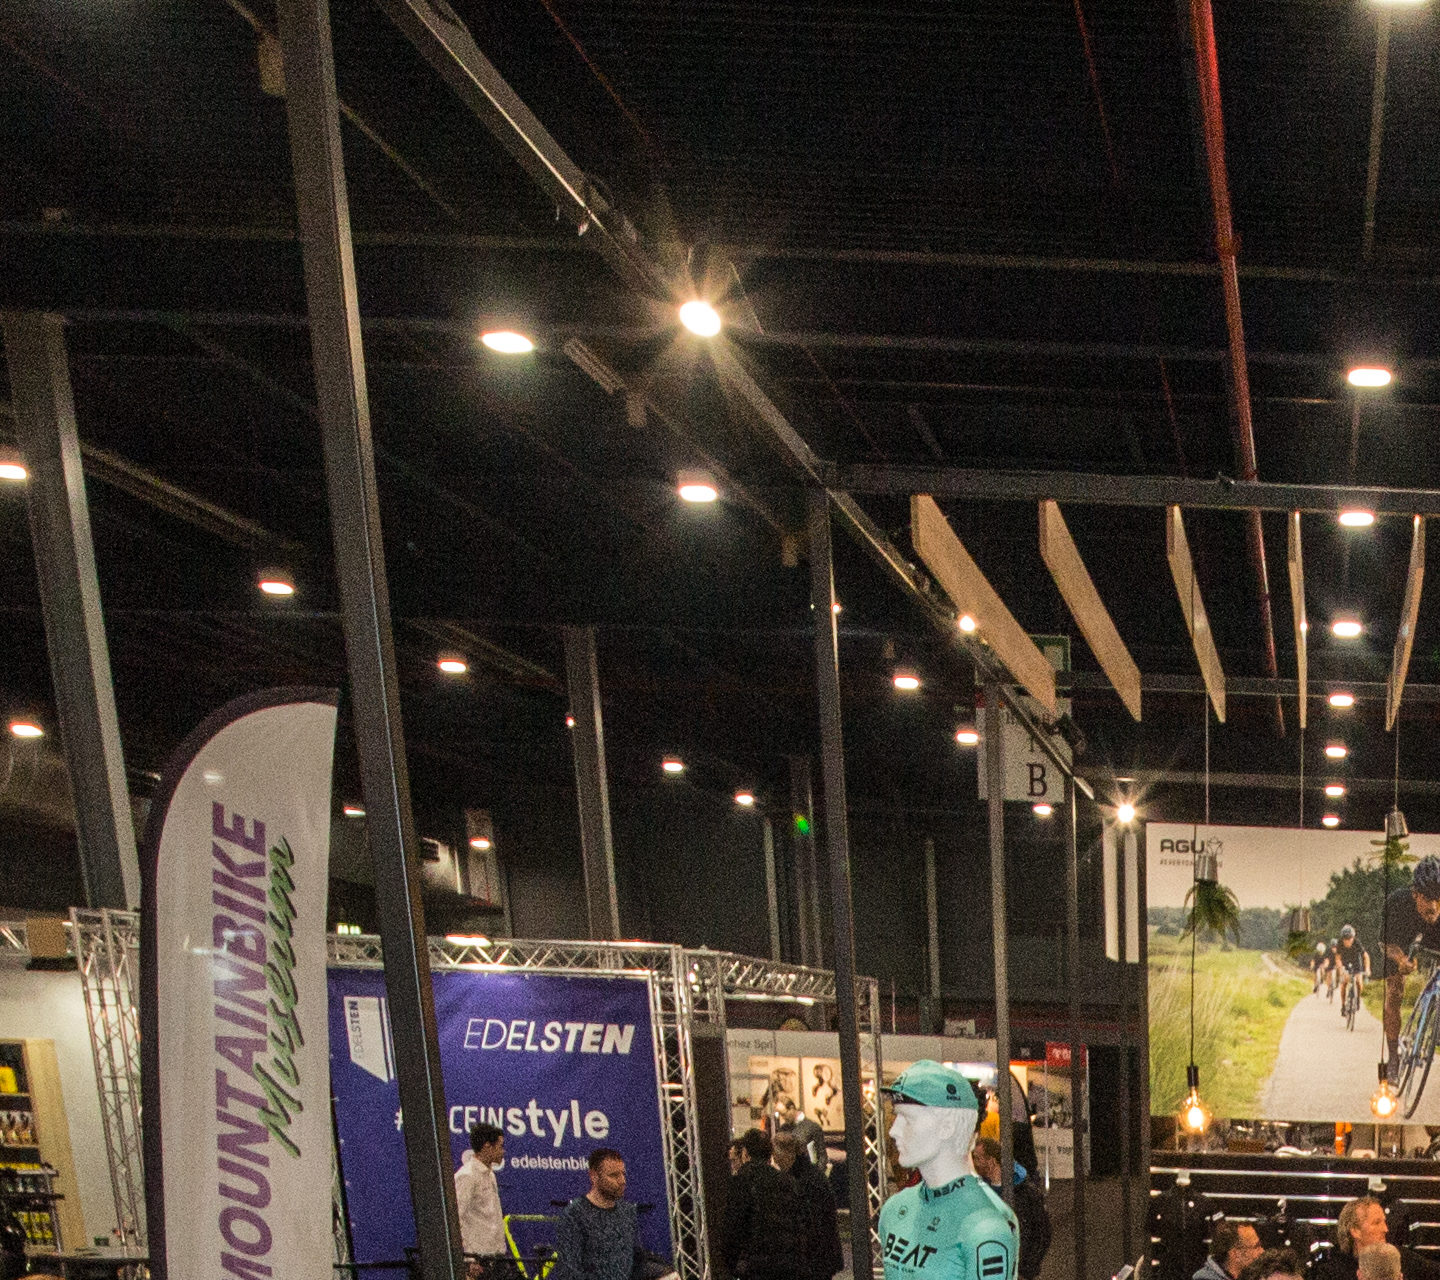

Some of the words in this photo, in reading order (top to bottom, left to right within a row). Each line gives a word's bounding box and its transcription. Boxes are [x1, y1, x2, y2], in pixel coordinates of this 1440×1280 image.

[1026, 763, 1048, 797] B
[252, 836, 303, 1159] Museum
[463, 1018, 636, 1056] EDELSTEN
[511, 1154, 590, 1172] edelstenbik
[933, 1177, 967, 1198] BEAT
[884, 1233, 937, 1268] BEAT
